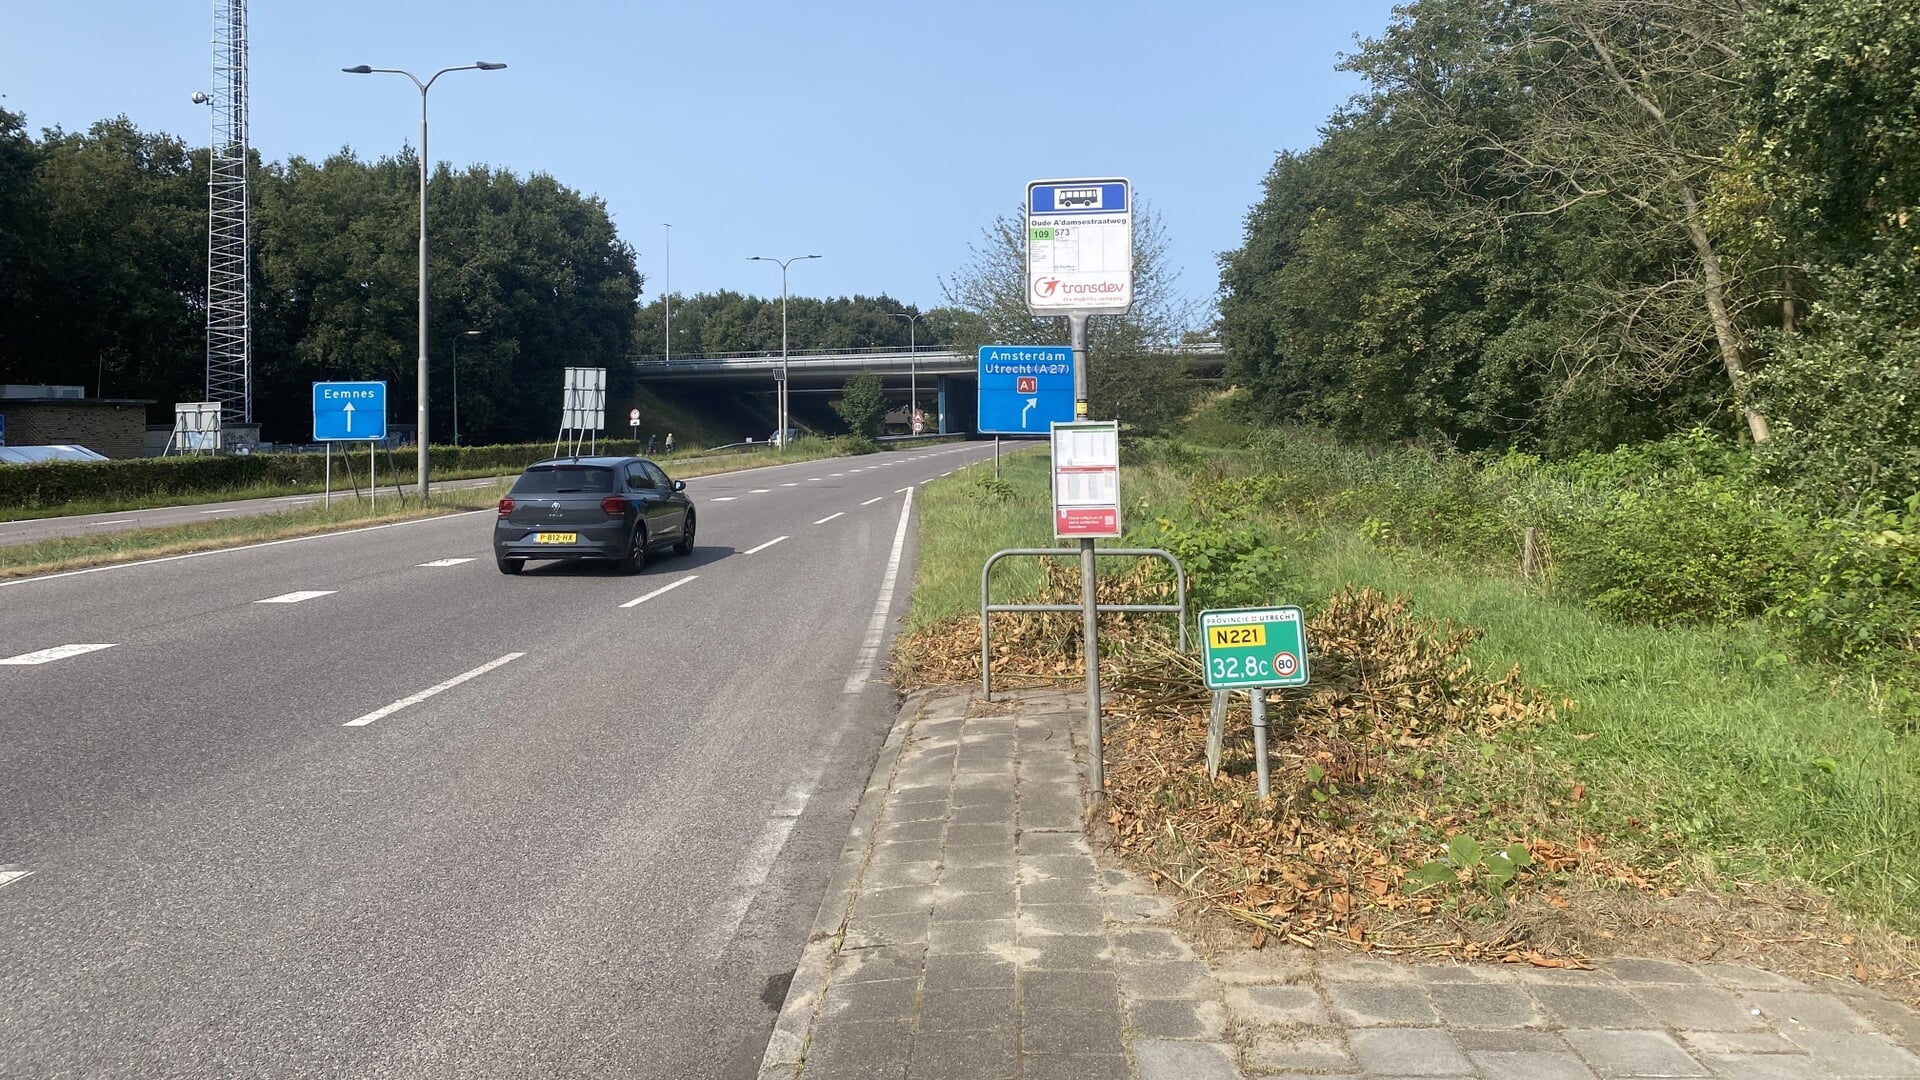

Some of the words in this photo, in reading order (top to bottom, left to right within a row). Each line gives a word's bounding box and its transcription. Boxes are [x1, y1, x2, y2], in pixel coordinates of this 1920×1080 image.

[1031, 219, 1052, 227] Oude
[1053, 218, 1126, 227] A'damsestraatweg
[1033, 230, 1049, 238] 109
[1055, 228, 1070, 236] 573
[1061, 281, 1124, 294] transdev
[990, 351, 1066, 361] Amsterdam
[985, 364, 1032, 374] Utrecht
[1034, 364, 1070, 375] (A27)
[1019, 380, 1035, 390] A1
[324, 389, 375, 399] Eemnes
[1259, 613, 1295, 621] UTRECHT
[1216, 628, 1258, 645] N221
[1278, 659, 1293, 669] 80
